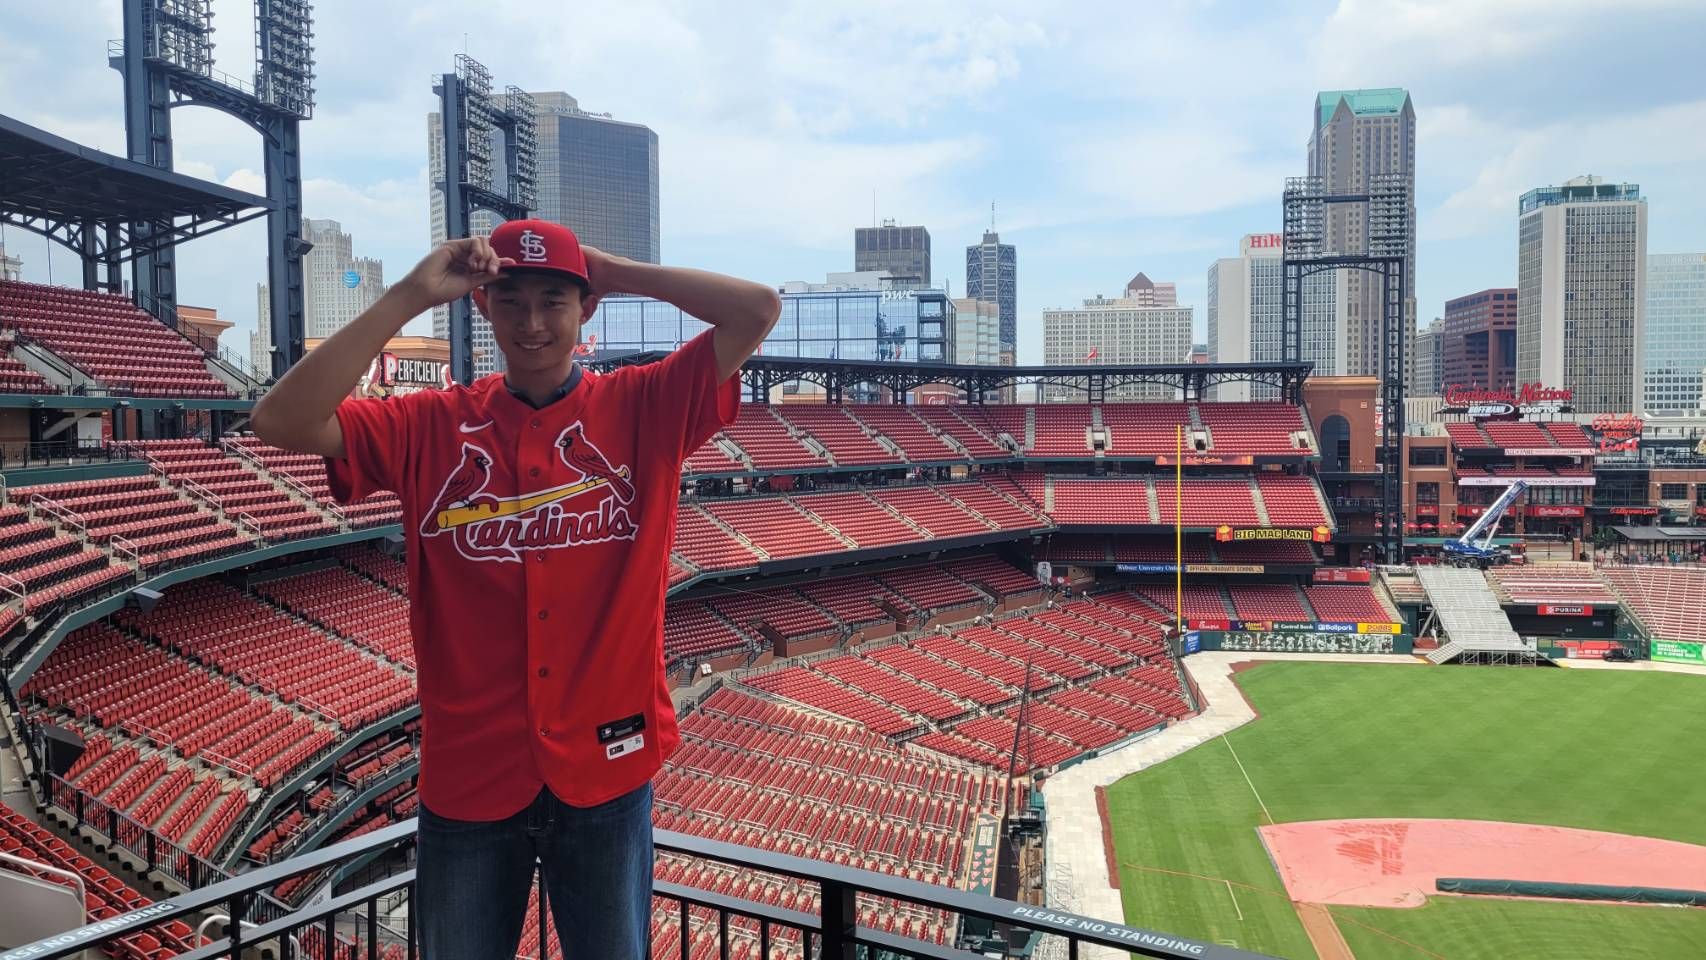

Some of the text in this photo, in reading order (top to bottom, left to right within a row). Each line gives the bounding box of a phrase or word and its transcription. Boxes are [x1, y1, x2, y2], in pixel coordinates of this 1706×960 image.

[1250, 234, 1282, 248] Hilt
[881, 289, 915, 304] pwc
[383, 353, 441, 385] PERFICIENT
[1446, 383, 1573, 406] Cardinals Nation
[453, 496, 640, 563] Cardinals
[1234, 529, 1312, 540] BIG MAC LAND
[1138, 564, 1164, 573] University
[1555, 606, 1582, 614] PURINA
[2, 903, 174, 960] ASE NO STANDING
[1013, 906, 1205, 954] PLEASE NO STANDING
